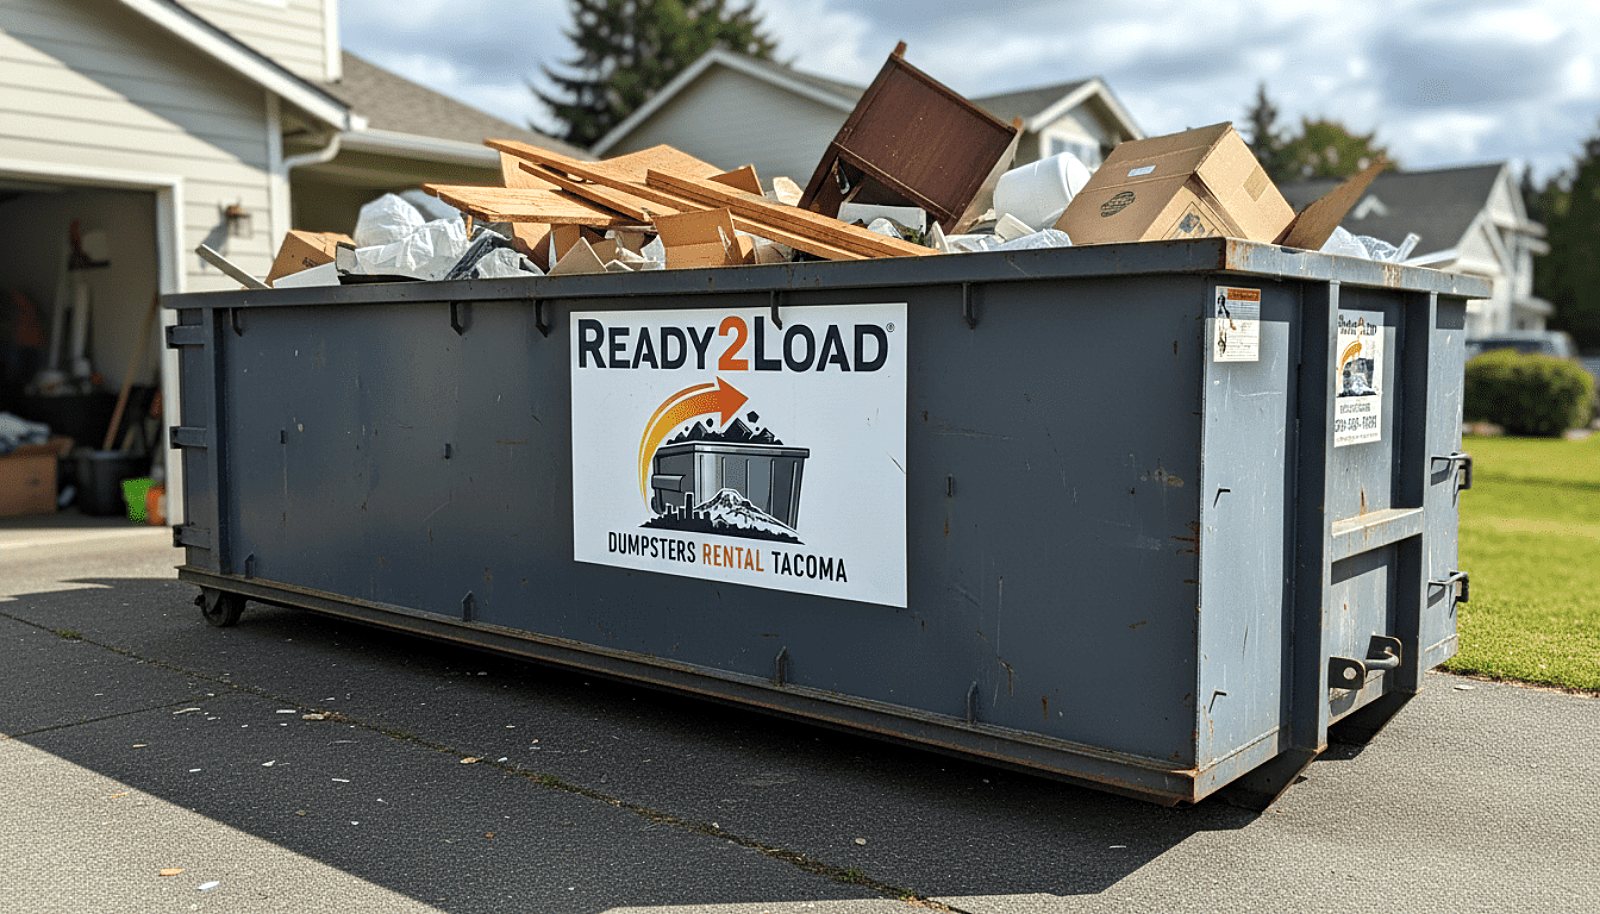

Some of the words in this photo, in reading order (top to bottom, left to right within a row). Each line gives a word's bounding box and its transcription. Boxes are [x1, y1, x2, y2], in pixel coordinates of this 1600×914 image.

[608, 531, 697, 563] DUMPSTERS
[702, 543, 765, 572] RENTAL
[772, 551, 848, 583] TACOMA
